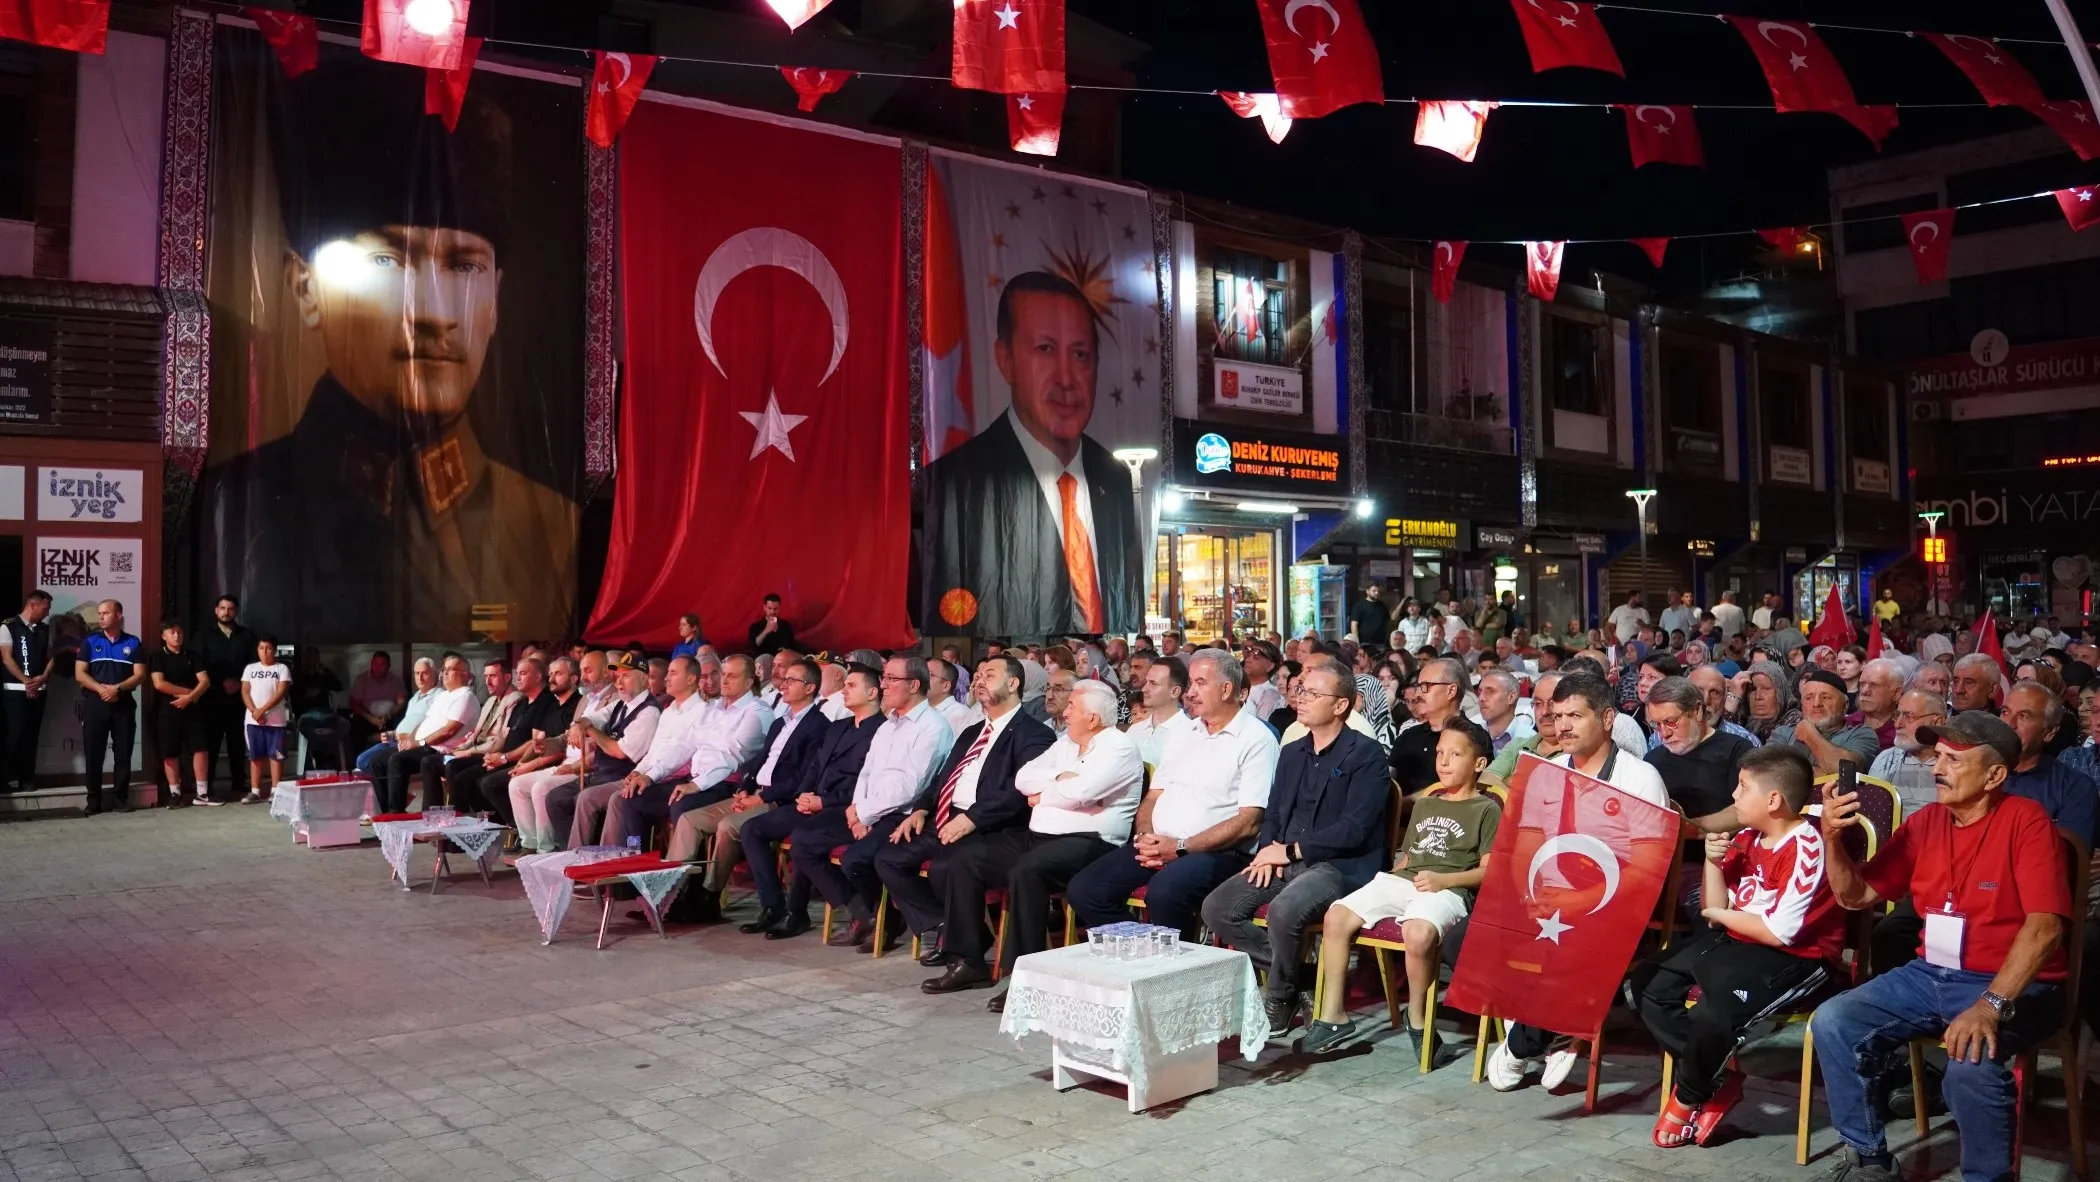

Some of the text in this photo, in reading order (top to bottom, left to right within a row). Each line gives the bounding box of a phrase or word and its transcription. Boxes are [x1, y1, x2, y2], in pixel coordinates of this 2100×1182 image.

[2015, 353, 2085, 382] SÜRÜCÜ
[1255, 375, 1286, 387] TÜRKİYE
[1232, 439, 1269, 461] DENİZ
[1235, 463, 1285, 477] KURUKAHVE
[1290, 468, 1337, 482] ŞEKERLEME
[70, 499, 118, 519] yeg
[1402, 519, 1457, 538] ERKANOĞLU
[1480, 532, 1493, 544] Çay
[251, 670, 280, 680] USPA
[1415, 816, 1465, 839] BURLINGTON
